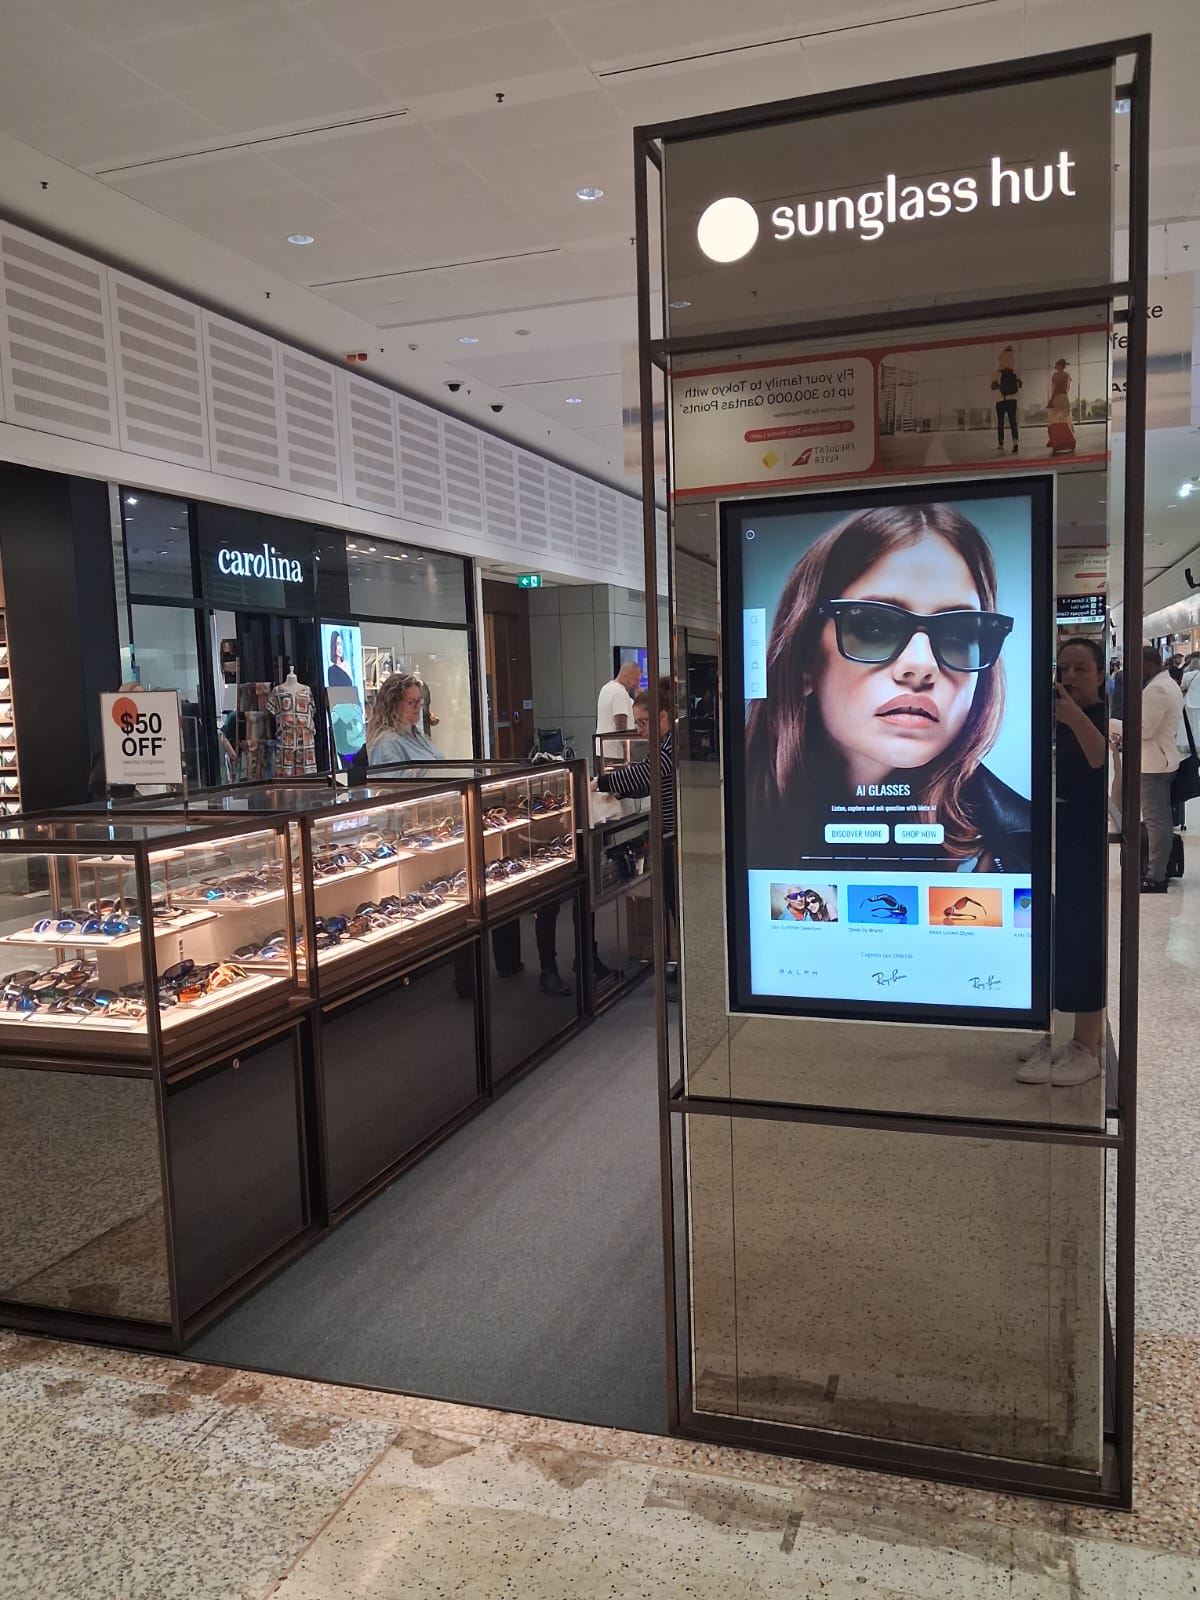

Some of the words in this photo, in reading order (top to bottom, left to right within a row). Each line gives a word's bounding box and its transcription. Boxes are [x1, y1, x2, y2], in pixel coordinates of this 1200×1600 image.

[772, 174, 978, 241] sunglass
[991, 151, 1076, 207] hut
[218, 543, 304, 583] carolina
[120, 710, 162, 736] $50
[856, 784, 866, 796] AI
[868, 784, 911, 796] GLASSES
[831, 830, 863, 838] DISCOVER
[864, 830, 882, 838] MORE
[901, 830, 919, 838] SHOP
[779, 968, 818, 976] RALPH
